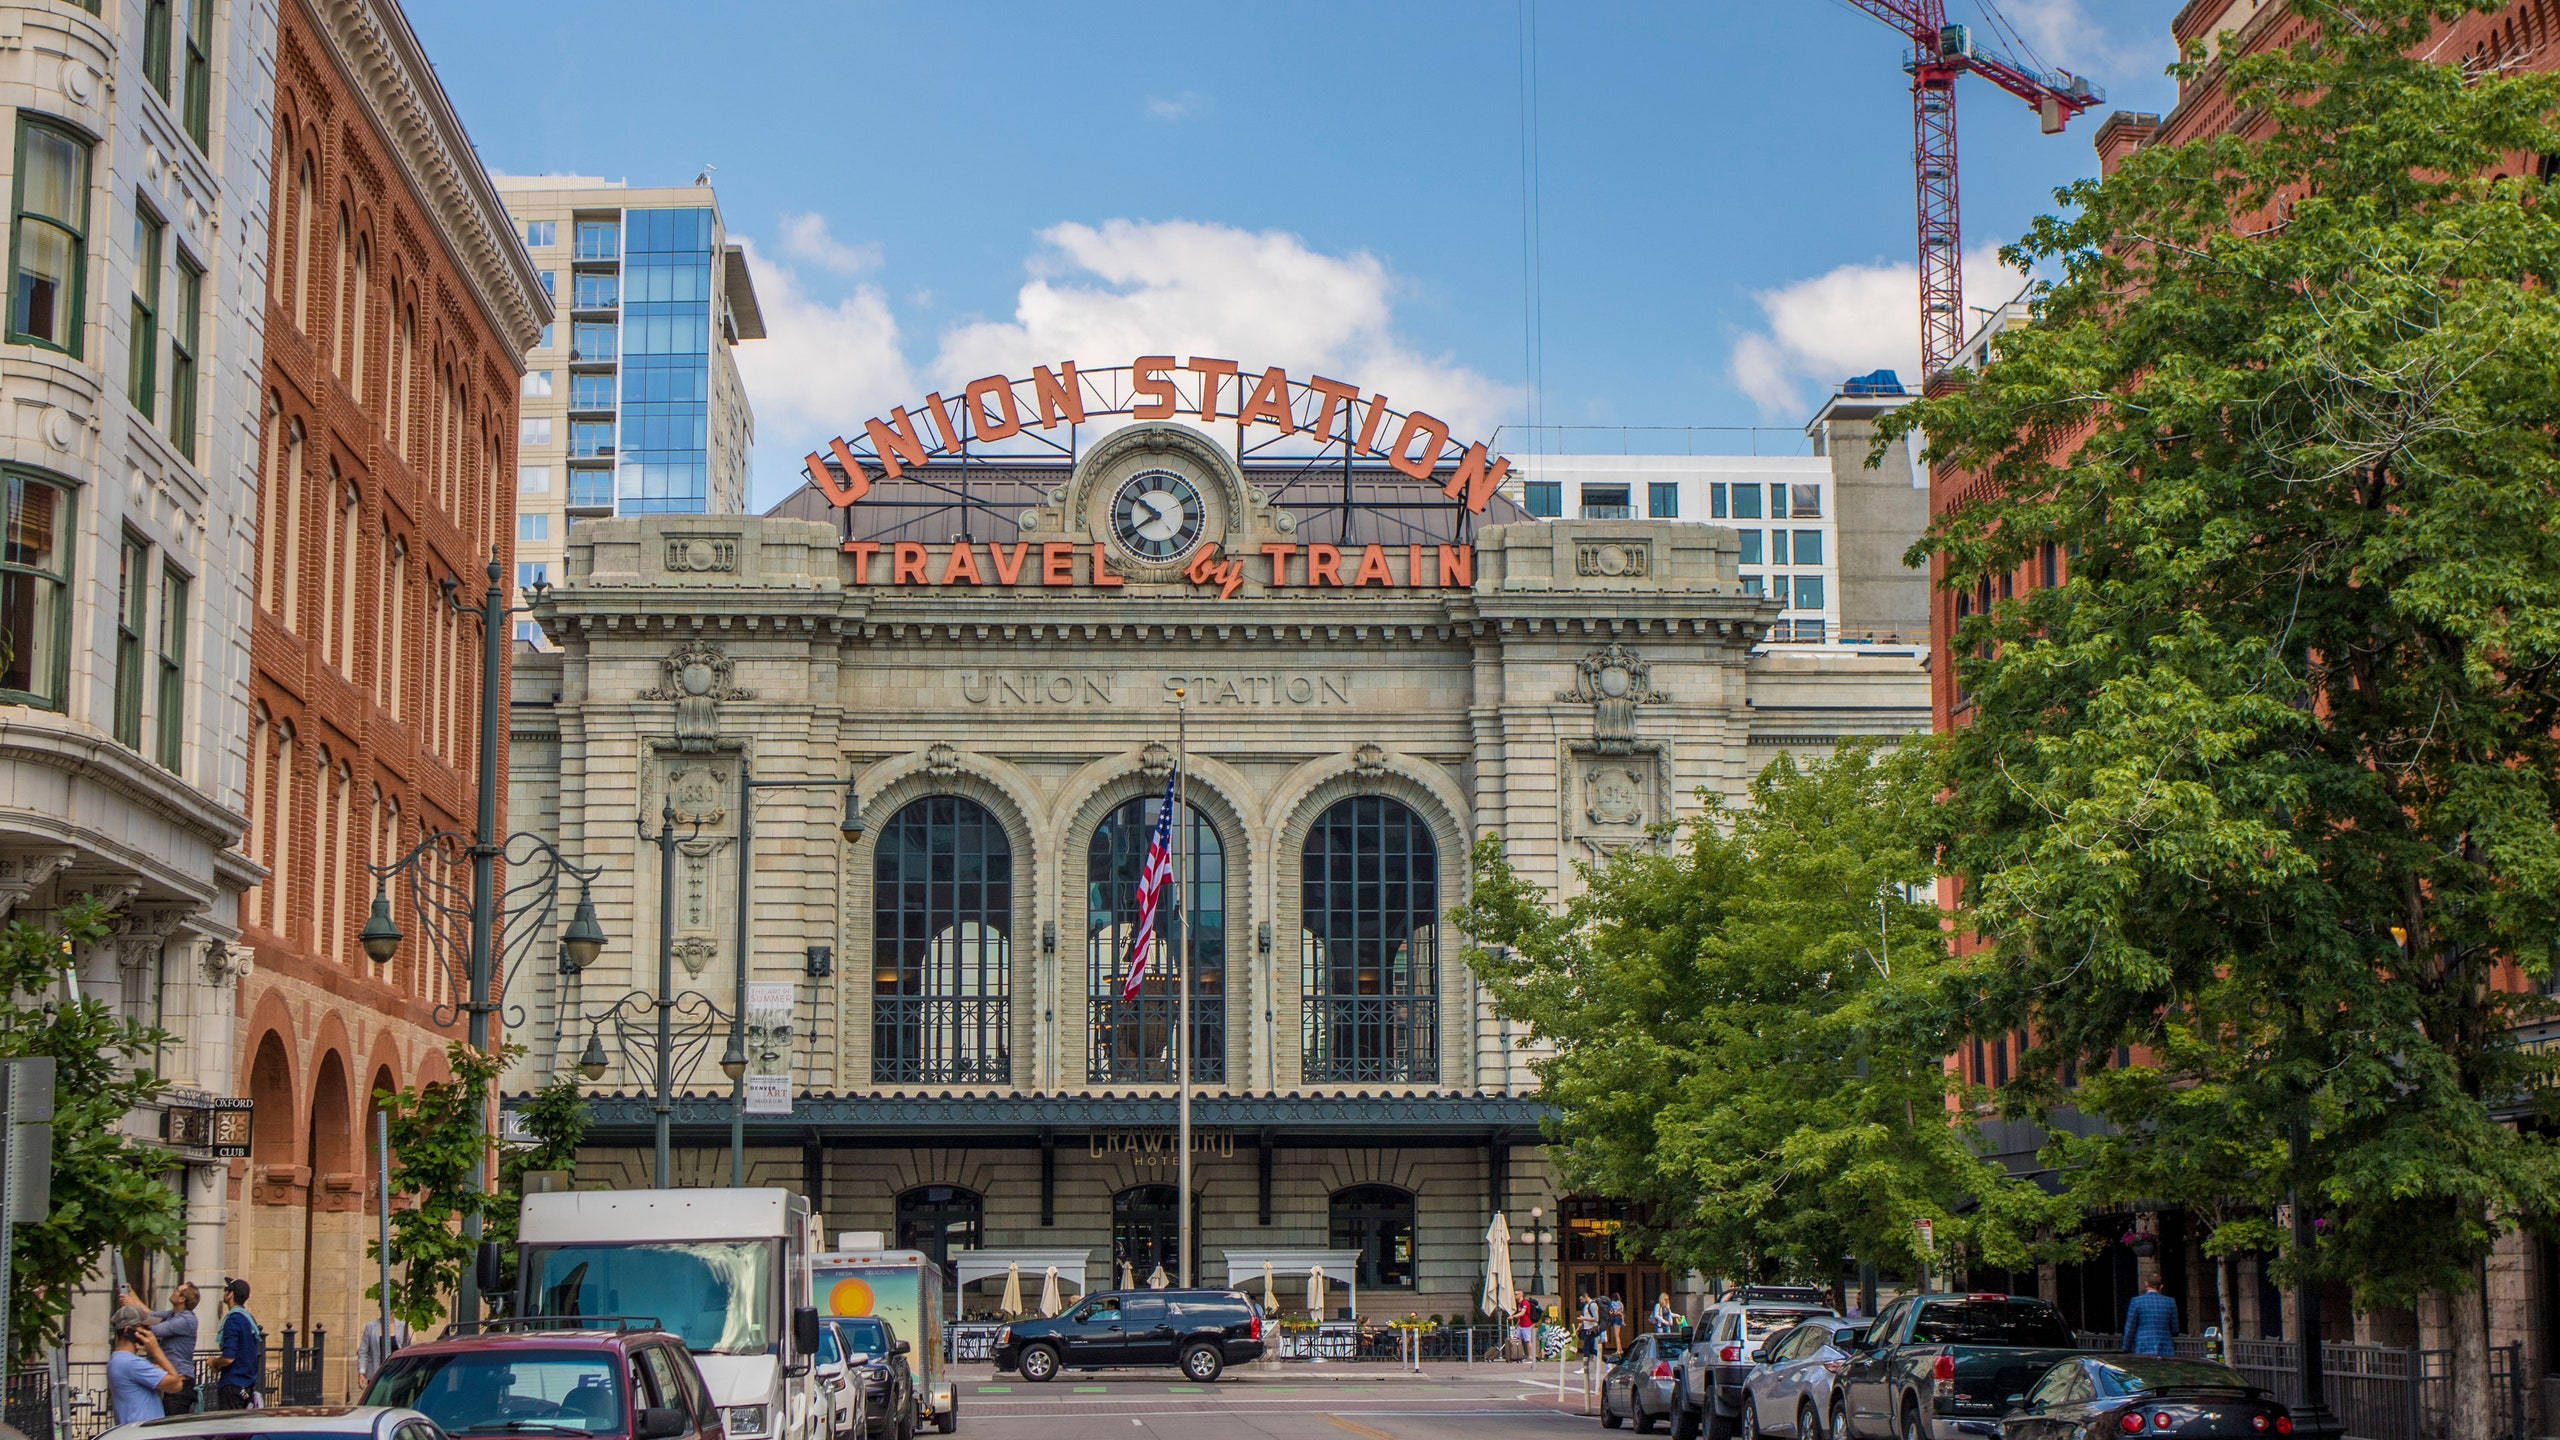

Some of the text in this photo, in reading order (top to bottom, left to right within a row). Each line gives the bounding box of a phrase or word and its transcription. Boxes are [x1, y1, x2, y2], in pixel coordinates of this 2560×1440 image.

[804, 355, 1510, 514] UNION STATION
[844, 541, 1472, 600] TRAVEL by TRAIN
[961, 674, 1353, 705] UNION STATION
[751, 995, 792, 1003] SUMMER
[767, 1088, 788, 1097] ART
[215, 1099, 253, 1108] OXFORD
[1090, 1126, 1235, 1158] CRAWFORD
[219, 1147, 245, 1157] CLUB
[1134, 1156, 1180, 1166] HOTE
